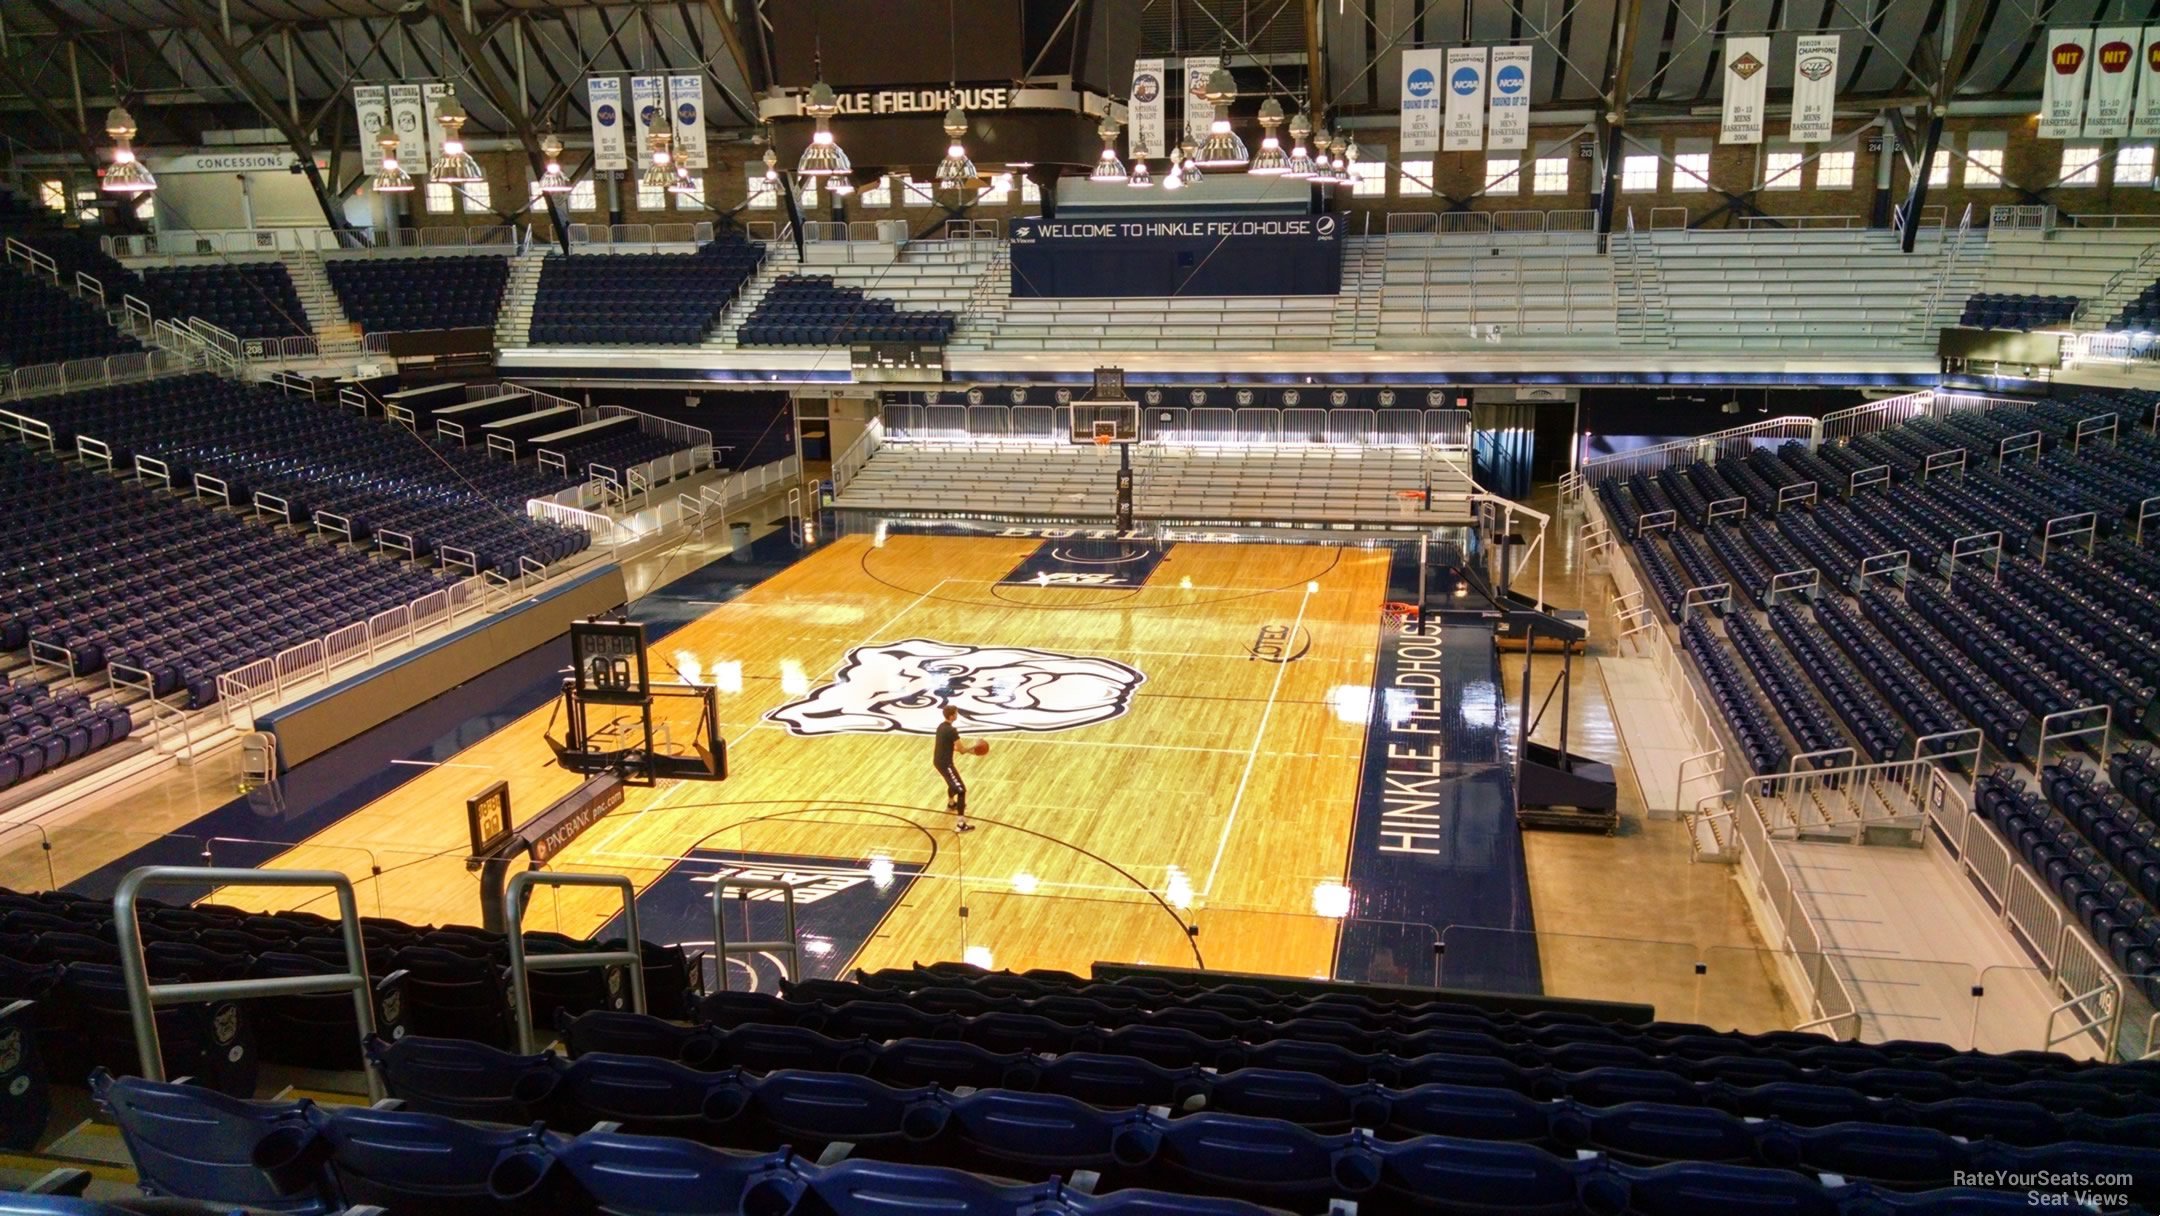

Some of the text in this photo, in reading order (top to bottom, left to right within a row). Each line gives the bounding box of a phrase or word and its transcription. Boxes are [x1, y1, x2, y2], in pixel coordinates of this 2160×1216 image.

[1798, 47, 1837, 55] CHAMPIONS
[2056, 53, 2078, 65] NIT
[2104, 51, 2127, 63] NIT
[1805, 62, 1829, 70] NIT
[1409, 81, 1434, 90] NCAA
[1454, 80, 1479, 89] NCAA
[1499, 79, 1524, 87] NCAA
[880, 88, 1007, 113] FIELDHOUSE
[1491, 128, 1526, 136] BASKETBALL
[1723, 124, 1760, 132] BASKETBALL
[1403, 130, 1437, 138] BASKETBALL
[1446, 129, 1480, 137] BASKETBALL
[196, 157, 283, 168] CONCESSIONS
[1037, 221, 1310, 237] WELCOME TO HINKLE FIELDHOUSE
[246, 346, 263, 354] 208
[1378, 743, 1441, 855] HINKLE
[592, 790, 622, 821] pnc.com
